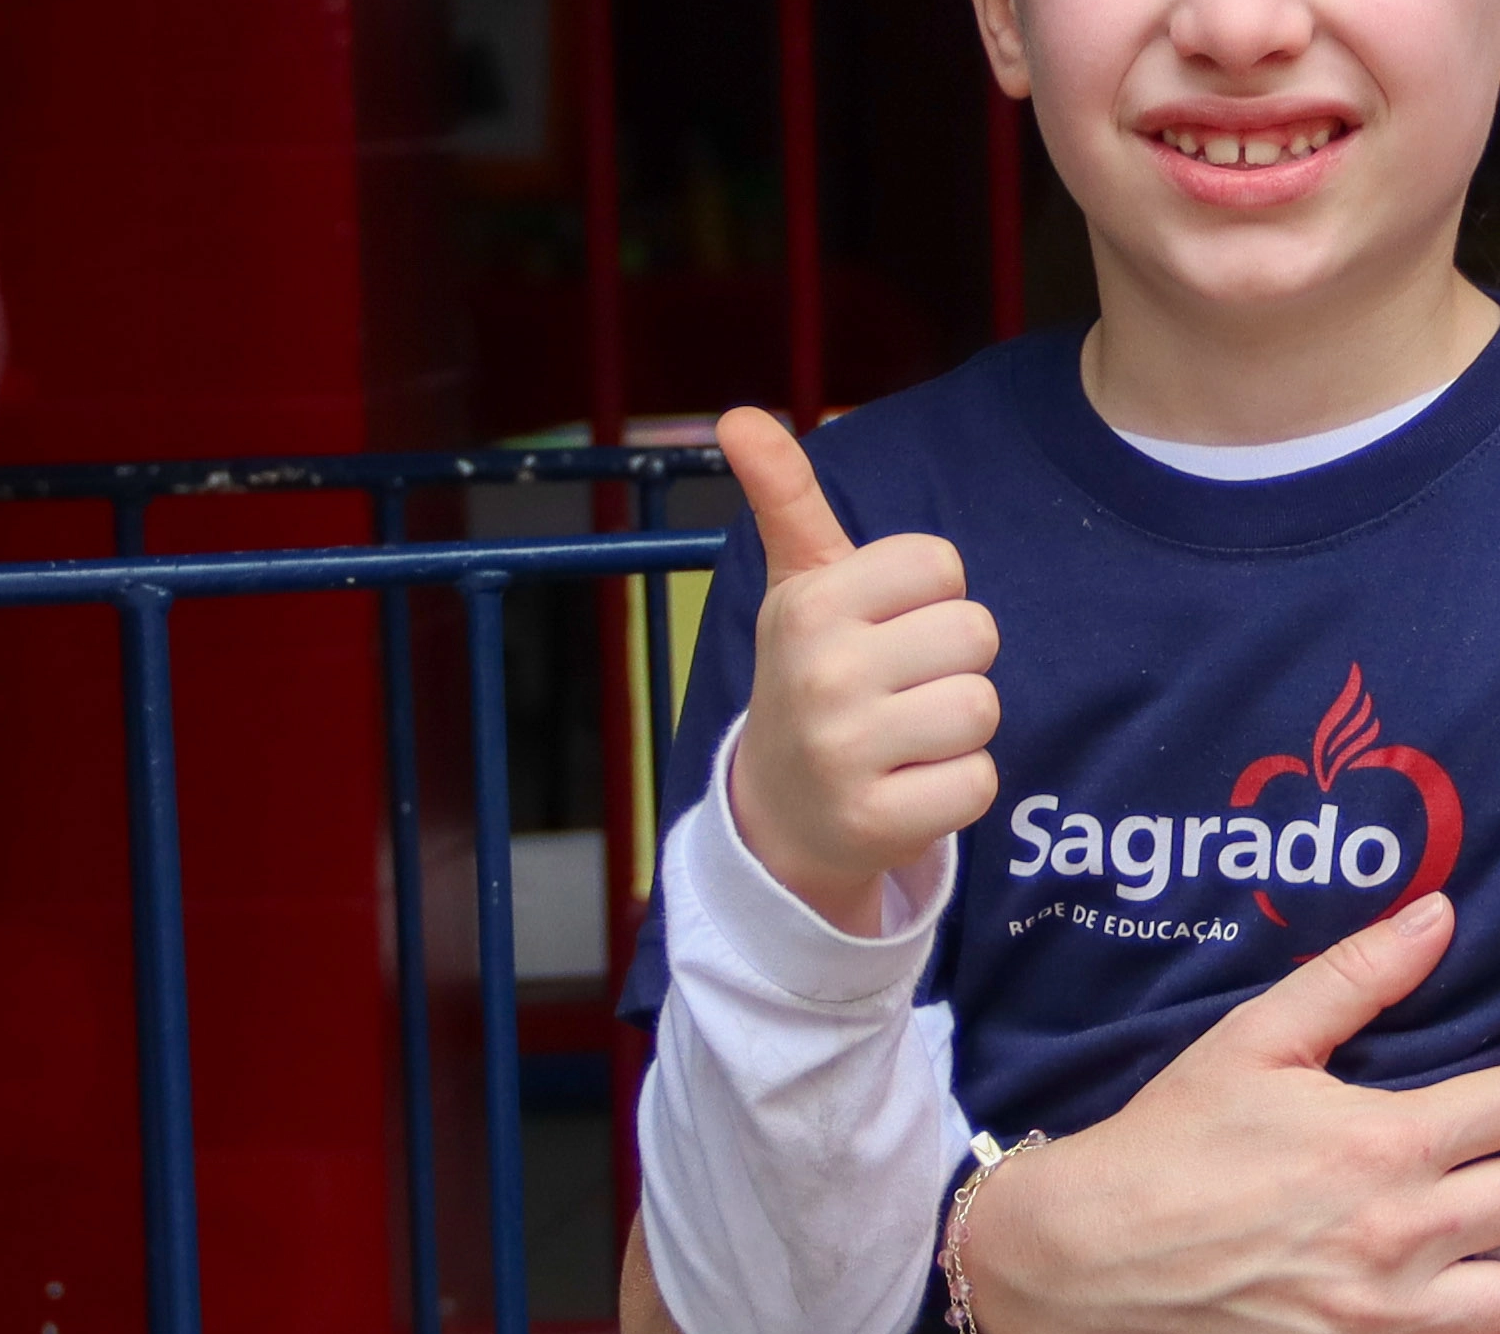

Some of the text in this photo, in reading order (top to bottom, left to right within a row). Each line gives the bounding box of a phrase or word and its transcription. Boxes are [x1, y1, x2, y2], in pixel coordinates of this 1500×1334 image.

[1008, 793, 1401, 902] Sagrado
[1071, 904, 1099, 929] DE
[1103, 915, 1239, 944] EDUCAÇÃO
